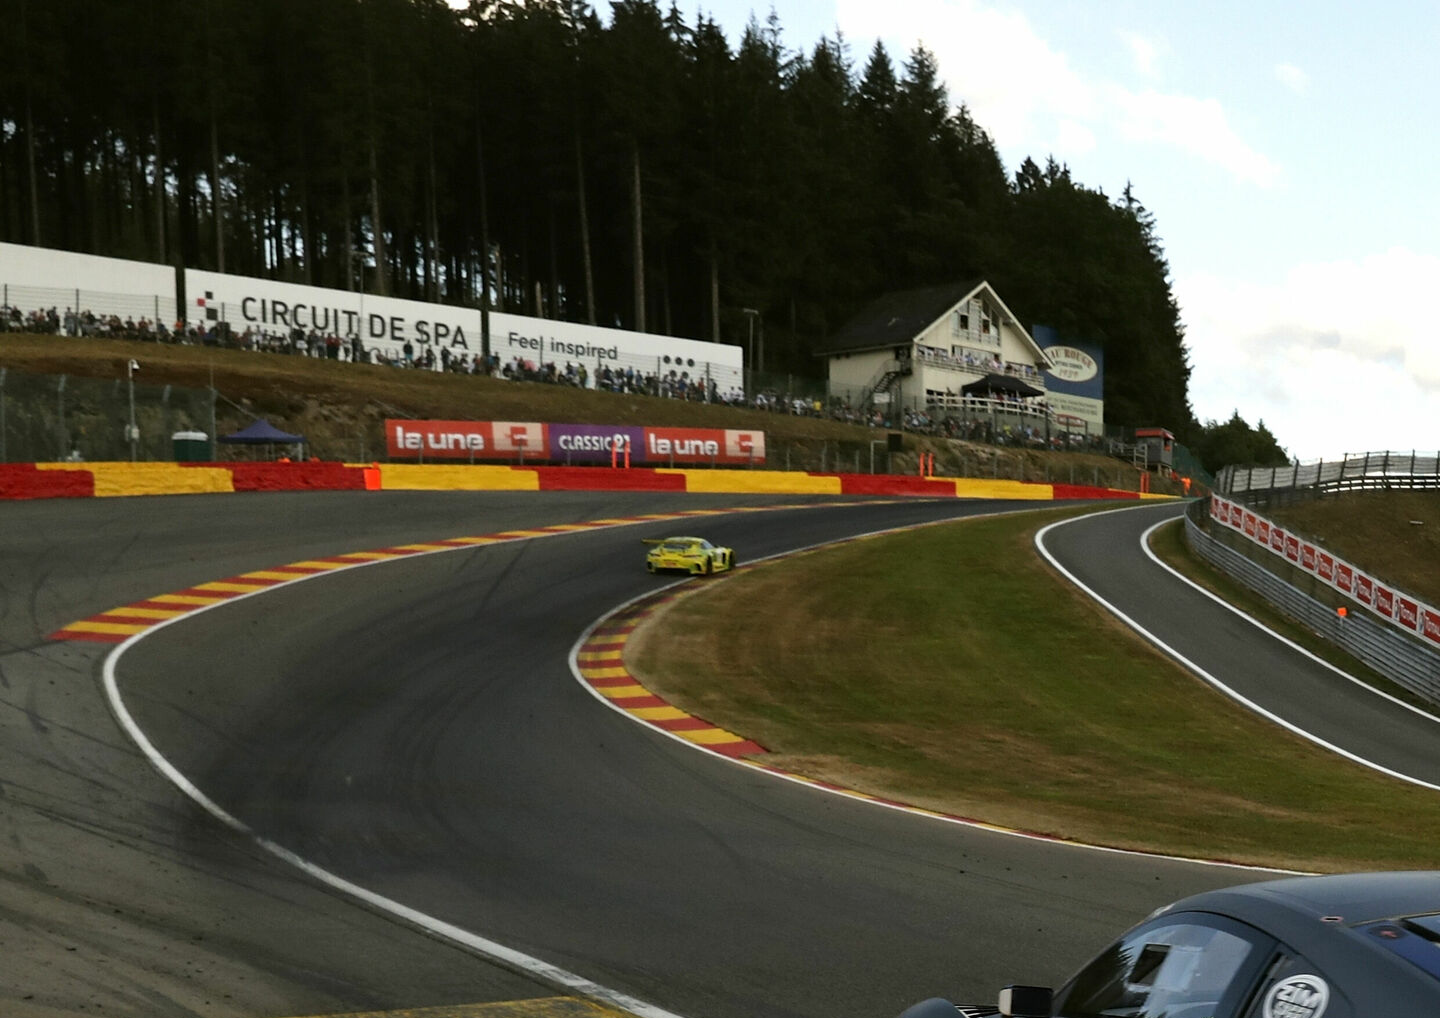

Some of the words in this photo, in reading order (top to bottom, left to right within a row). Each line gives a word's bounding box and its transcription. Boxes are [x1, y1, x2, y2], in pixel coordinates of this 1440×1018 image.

[242, 297, 358, 333] CIRCUIT
[369, 313, 405, 341] DE
[415, 320, 469, 349] SPA
[508, 332, 544, 350] Feel
[551, 338, 618, 361] inspired
[396, 426, 423, 449] la
[428, 432, 484, 449] une
[649, 433, 674, 454] la
[675, 440, 718, 455] une
